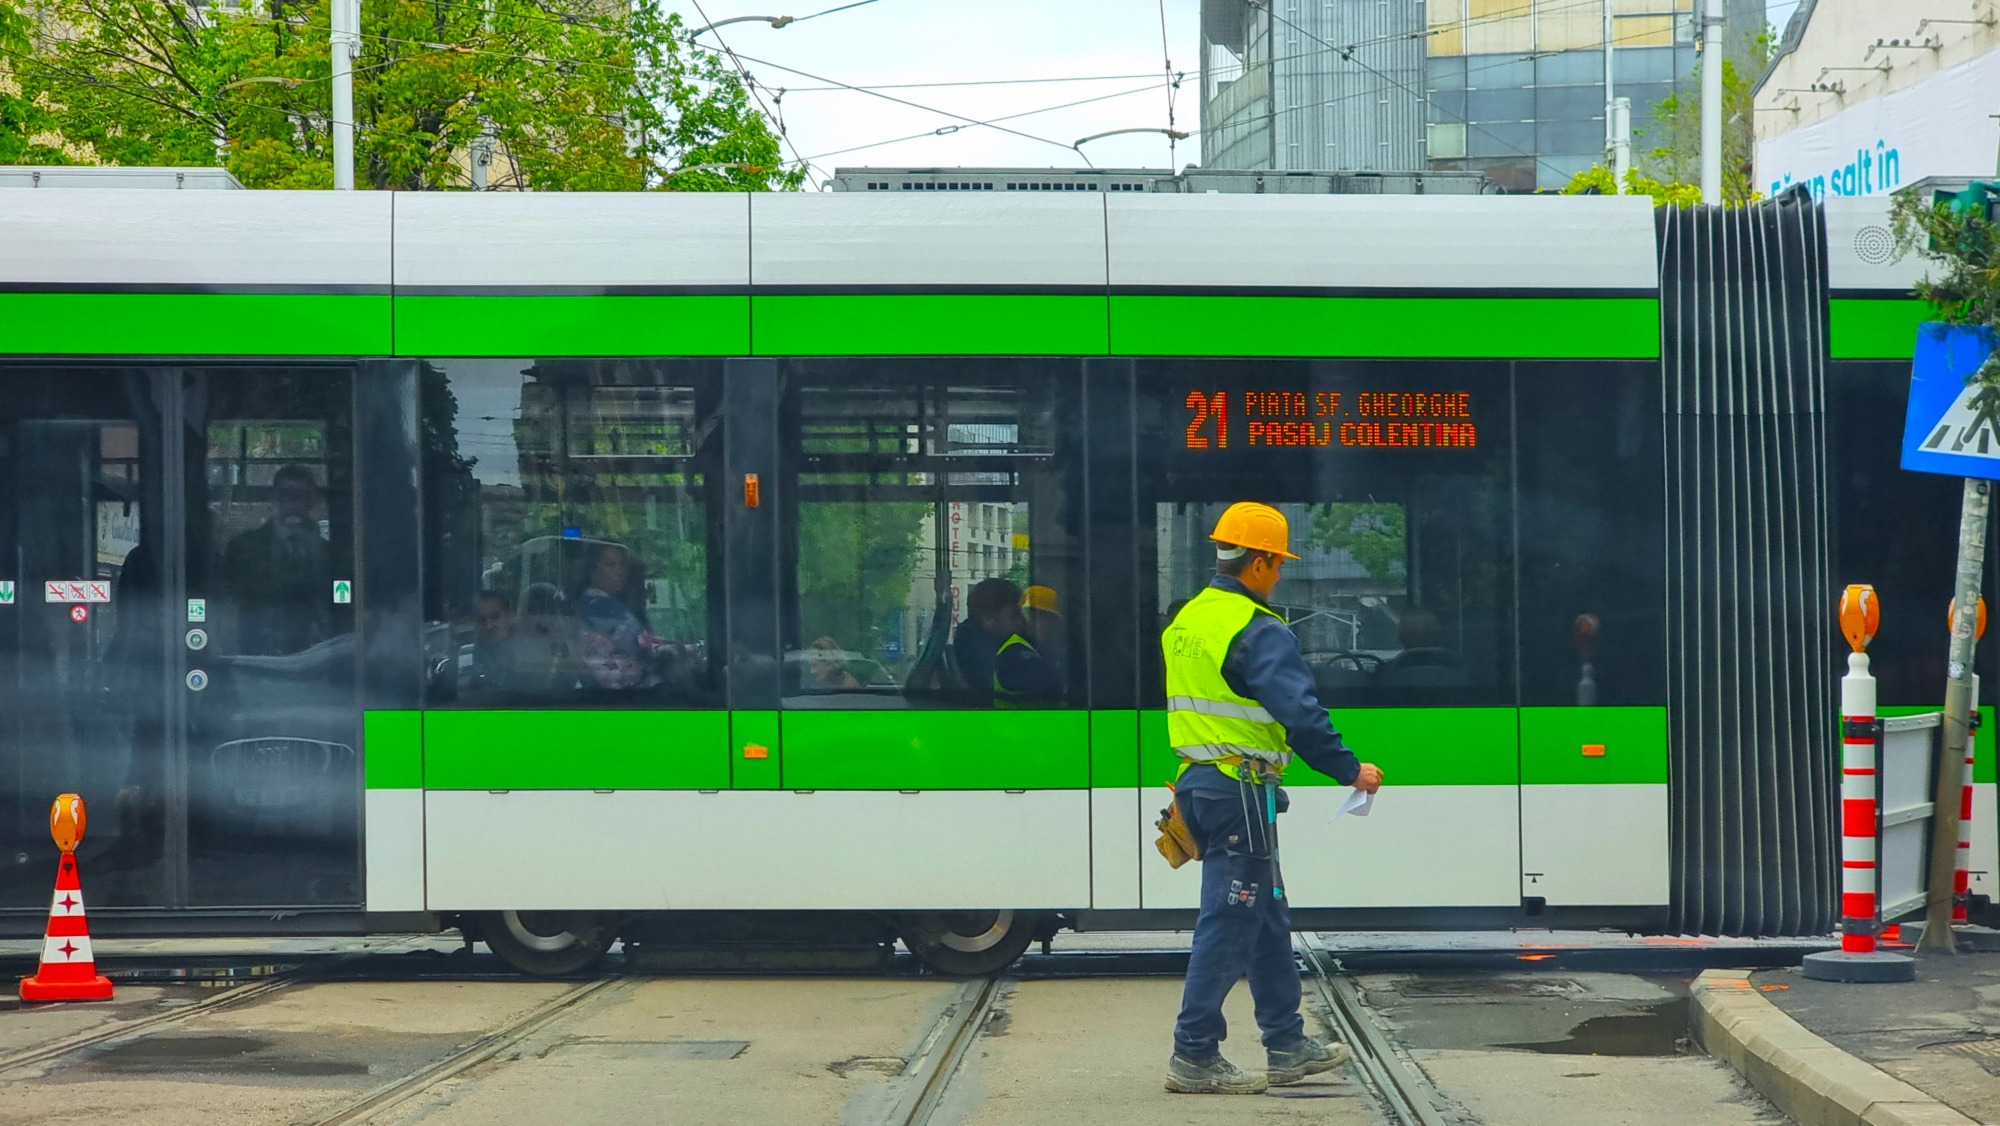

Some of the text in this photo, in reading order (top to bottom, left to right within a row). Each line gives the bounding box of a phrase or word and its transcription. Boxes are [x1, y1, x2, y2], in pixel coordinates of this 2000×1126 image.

[1831, 148, 1872, 197] salt
[1877, 138, 1900, 191] în
[1185, 391, 1227, 448] 21
[1245, 391, 1471, 418] PIATA SF. GHEORGHE
[1249, 421, 1477, 447] PASAJ COLENTINA
